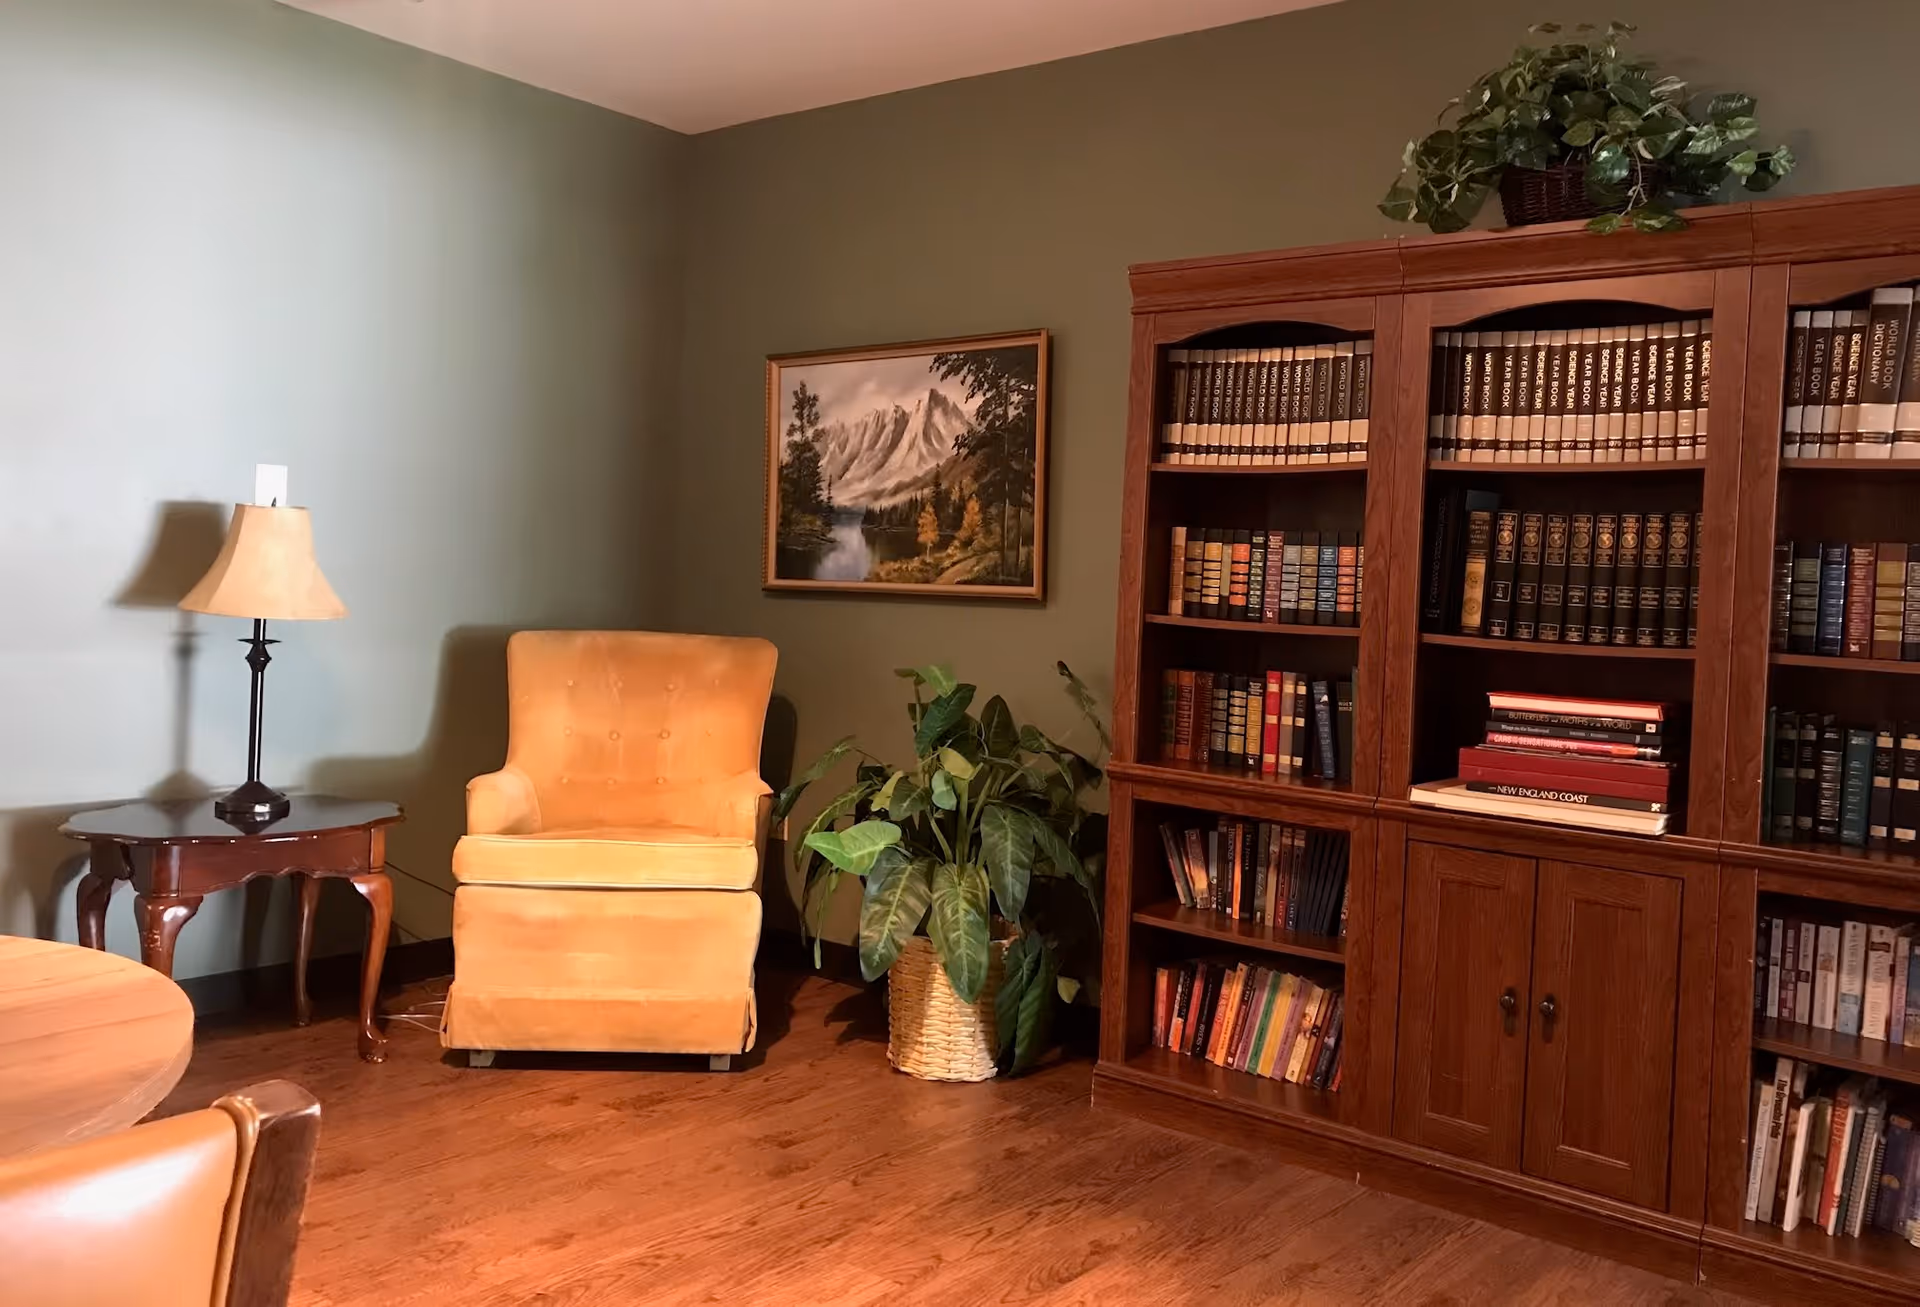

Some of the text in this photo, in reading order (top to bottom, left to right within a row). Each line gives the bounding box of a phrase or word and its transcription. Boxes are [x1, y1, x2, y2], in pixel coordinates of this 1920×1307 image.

[1482, 353, 1492, 410] WORLD BOOK
[1502, 355, 1512, 408] YEAR BOOK
[1534, 351, 1545, 409] SCIENCE YEAR
[1567, 351, 1577, 409] SCIENCE YEAR
[1600, 349, 1610, 408] SCIENCE YEAR
[1614, 348, 1624, 407] SCIENCE YEAR
[1631, 350, 1640, 404] YEAR BOOK
[1647, 345, 1657, 406] SCIENCE YEAR
[1665, 346, 1674, 402] YEAR BOOK
[1684, 345, 1694, 401] YEAR BOOK
[1700, 340, 1711, 402] SCIENCE YEAR
[1811, 337, 1824, 396] YEAR BOOK
[1830, 335, 1845, 399] SCIENCE YEAR
[1847, 333, 1862, 398] SCIENCE YEAR
[1870, 324, 1885, 384] DICTIONARY
[1882, 319, 1899, 390] WORLD BOOK
[1519, 382, 1527, 408] BOOK
[1550, 381, 1559, 407] BOOK
[1583, 380, 1591, 406] BOOK
[1494, 735, 1511, 743] CARS
[1508, 712, 1550, 722] BUTTERFLIES
[1560, 716, 1588, 726] MOTHS
[1601, 720, 1632, 730] WORLD
[1497, 785, 1588, 803] NEW ENGLAND COAST
